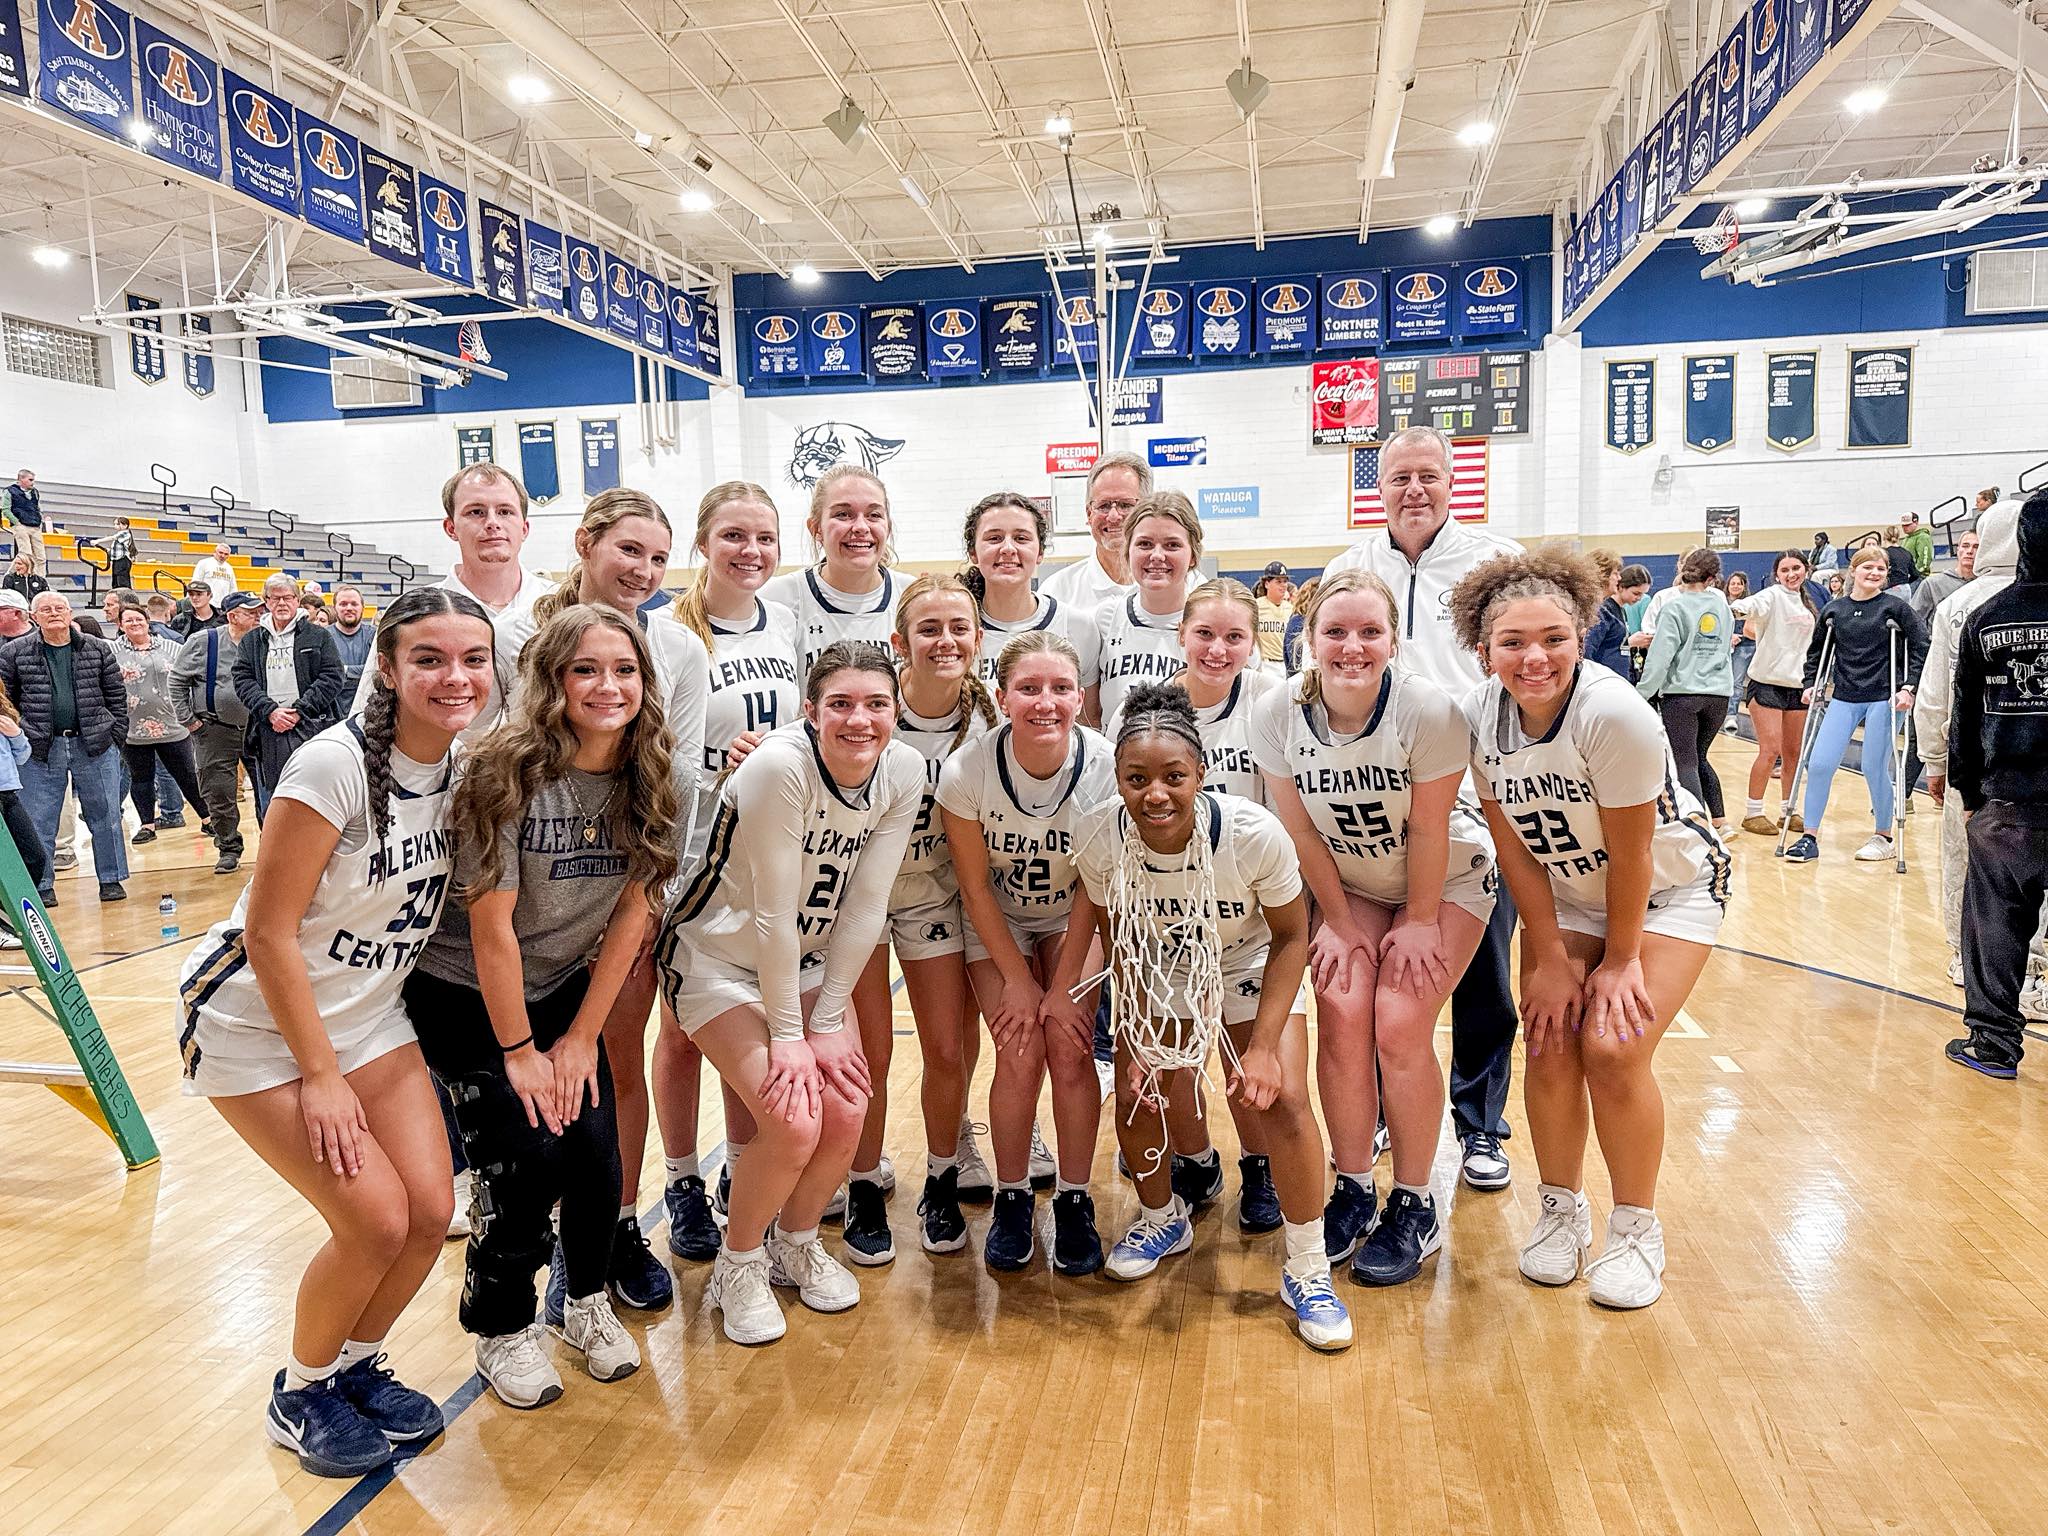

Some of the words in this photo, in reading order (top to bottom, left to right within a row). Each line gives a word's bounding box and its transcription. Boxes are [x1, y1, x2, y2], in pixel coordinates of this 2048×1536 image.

[62, 55, 96, 75] TIMBER
[104, 80, 130, 112] FARMS
[145, 97, 215, 149] HUNTINGTON
[235, 147, 263, 174] Cowboy
[310, 193, 359, 222] TAYLORSVILLE
[1395, 304, 1405, 312] Go
[1405, 302, 1432, 312] Cougars
[1265, 315, 1307, 326] PIEDMONT
[1395, 320, 1415, 328] Scott
[1324, 331, 1362, 341] LUMBER
[1384, 360, 1419, 372] GUEST
[1490, 354, 1522, 365] HOME
[1854, 353, 1885, 369] ALEXANDER
[1884, 353, 1908, 366] CENTRAL
[1690, 372, 1731, 380] CHAMPIONS
[1771, 368, 1812, 377] CHAMPIONS
[1866, 366, 1896, 374] STATE
[1392, 372, 1416, 394] 48
[1495, 367, 1520, 388] 61
[1611, 377, 1650, 386] CHAMPIONS
[1854, 372, 1908, 383] CHAMPIONS
[1426, 388, 1457, 398] PERIOD
[1430, 404, 1476, 413] PLAYER-FOUL
[1494, 401, 1517, 410] FOULS
[1314, 429, 1345, 437] ALWAYS
[1322, 435, 1342, 444] YOUR
[1154, 443, 1200, 455] MCDOWELL
[1166, 452, 1189, 463] Titans
[1056, 458, 1092, 471] Patriots
[1204, 491, 1252, 504] WATAUGA
[1212, 504, 1246, 515] Pioneers
[1983, 628, 2022, 651] TRUE
[742, 690, 778, 732] 14
[1294, 764, 1411, 795] ALEXANDER
[1328, 800, 1393, 838] 25
[1512, 809, 1582, 854] 33
[554, 857, 624, 879] BASKETBALL
[1007, 858, 1051, 891] 22
[385, 872, 449, 932] 30
[29, 913, 55, 960] WERNER
[926, 923, 950, 941] A
[1238, 979, 1261, 996] A
[54, 969, 93, 1028] ACHS
[80, 1026, 131, 1120] Athletics
